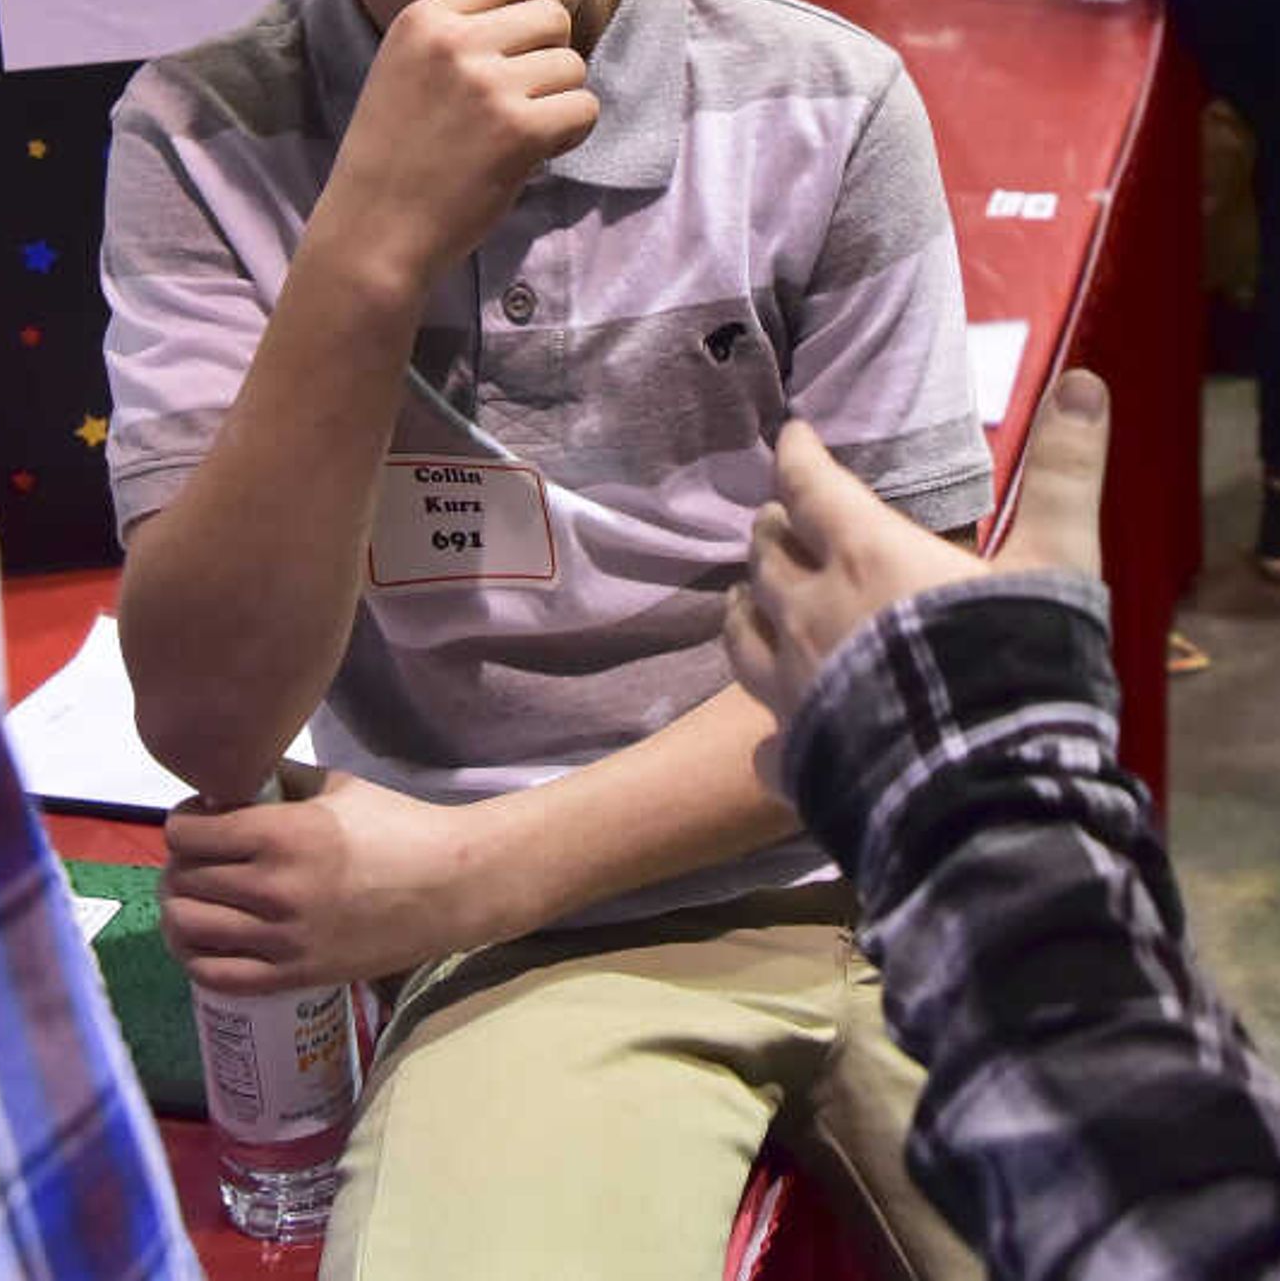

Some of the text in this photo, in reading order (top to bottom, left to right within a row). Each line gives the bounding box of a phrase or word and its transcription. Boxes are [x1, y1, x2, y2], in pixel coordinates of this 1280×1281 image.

[415, 468, 483, 484] Collin
[424, 496, 483, 514] Kurz
[431, 528, 485, 552] 691
